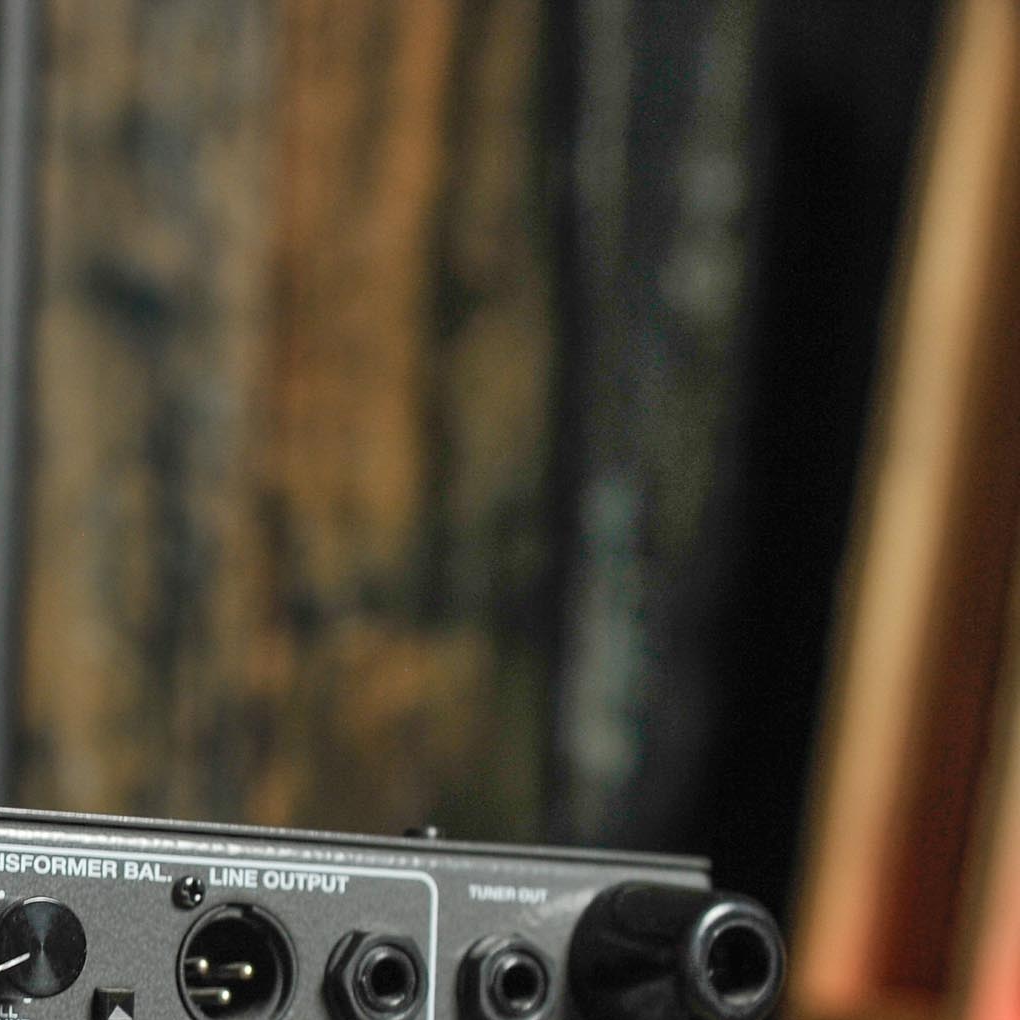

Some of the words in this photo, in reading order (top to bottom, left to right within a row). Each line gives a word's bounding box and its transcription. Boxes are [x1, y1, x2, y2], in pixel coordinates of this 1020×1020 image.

[124, 862, 173, 883] BAL.
[209, 867, 258, 888] LINE
[263, 871, 350, 894] OUTPUT
[469, 884, 516, 900] TUNER
[518, 886, 548, 902] OUT
